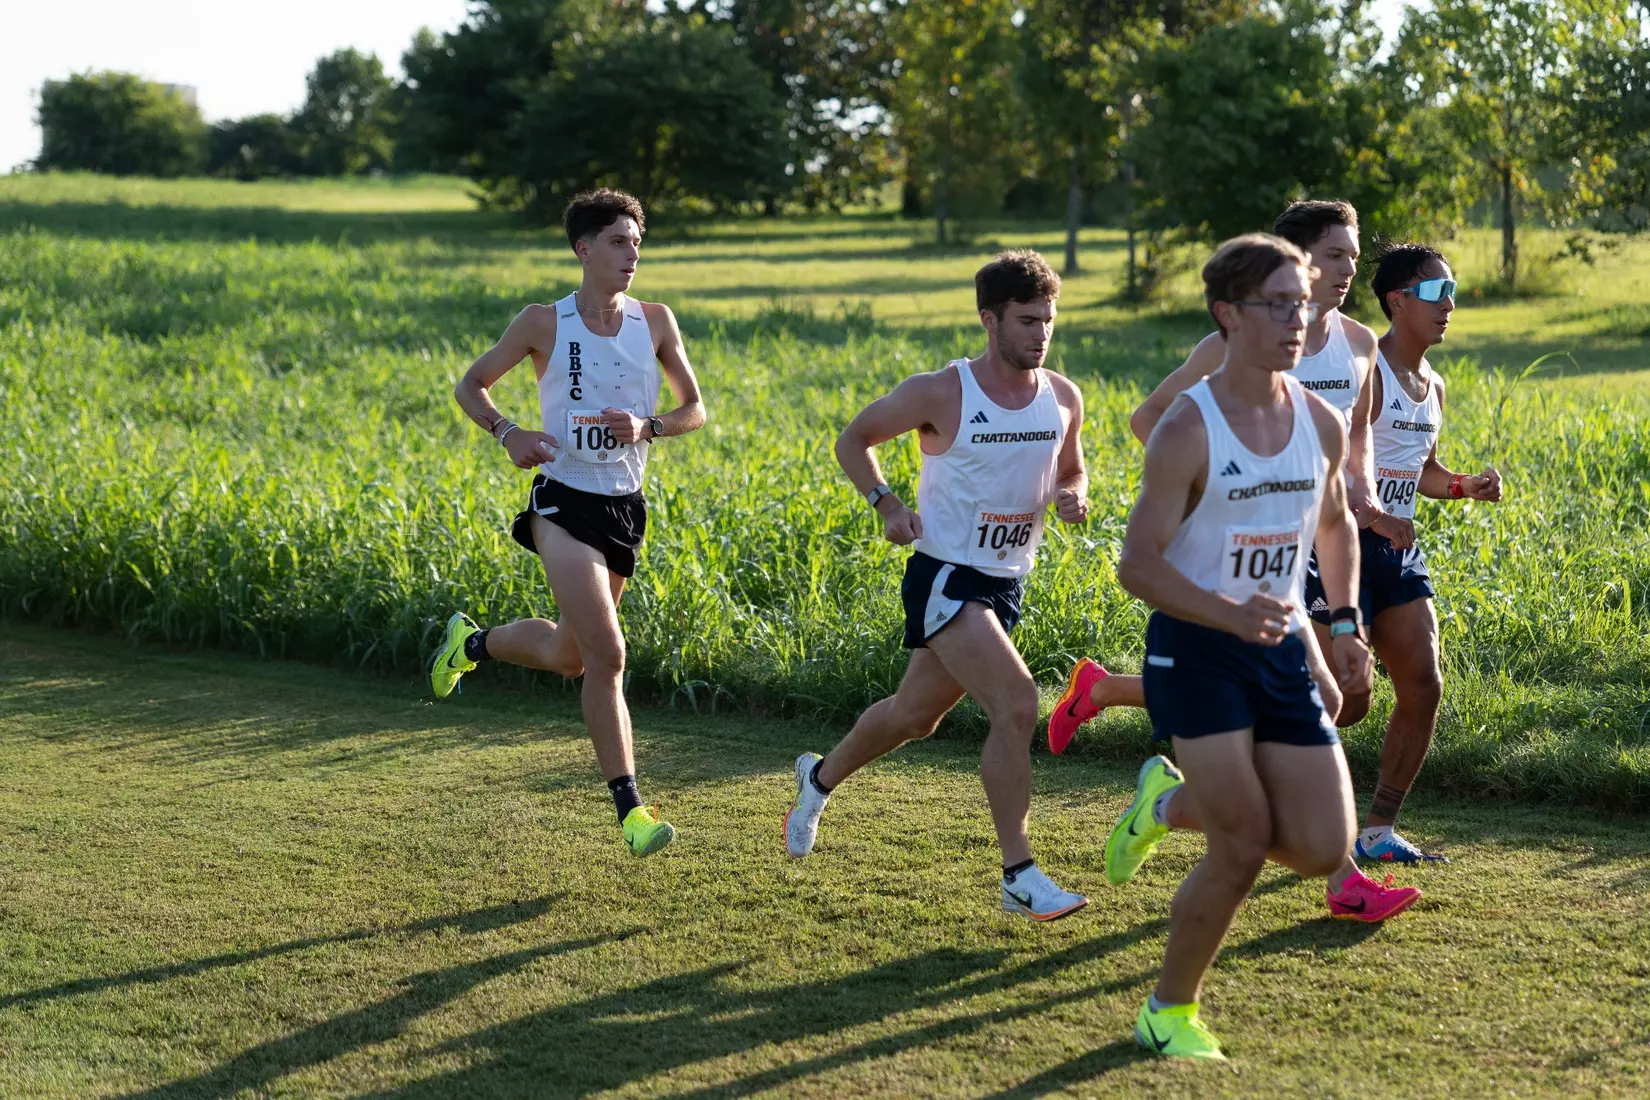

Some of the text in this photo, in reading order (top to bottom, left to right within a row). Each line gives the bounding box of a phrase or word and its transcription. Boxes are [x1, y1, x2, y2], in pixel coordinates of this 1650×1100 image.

[568, 341, 583, 401] BBTC
[572, 426, 624, 450] 108
[971, 430, 1057, 444] CHATTANOOGA
[1377, 467, 1419, 480] TENNESSEE
[1376, 479, 1416, 506] 1049
[980, 511, 1036, 523] TENNESSEE
[977, 522, 1033, 550] 1046
[1232, 530, 1299, 546] TENNESSEE
[1230, 544, 1299, 579] 1047
